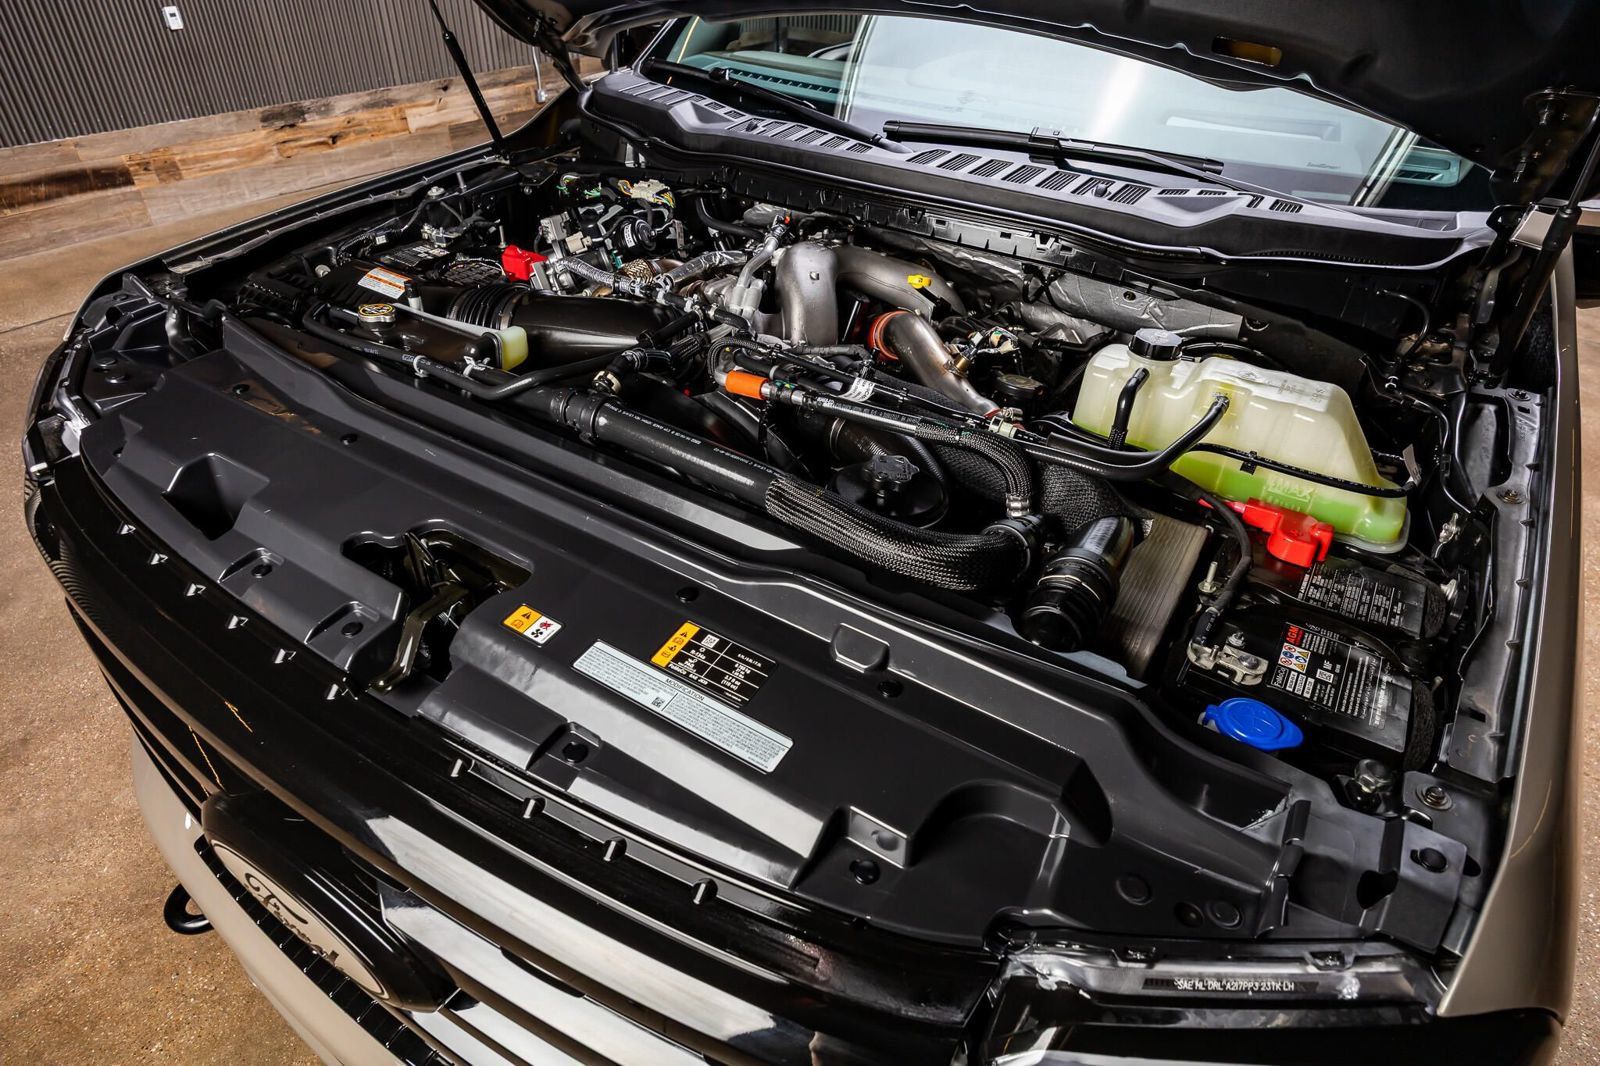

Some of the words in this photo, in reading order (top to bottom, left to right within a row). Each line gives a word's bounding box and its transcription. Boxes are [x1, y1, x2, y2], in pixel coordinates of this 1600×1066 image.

[1286, 625, 1300, 644] AGM
[1274, 667, 1286, 688] FoMoCo
[666, 678, 705, 701] MODIFICATION
[1177, 979, 1193, 991] SAE
[1208, 979, 1224, 991] DRL
[1283, 979, 1295, 991] LH
